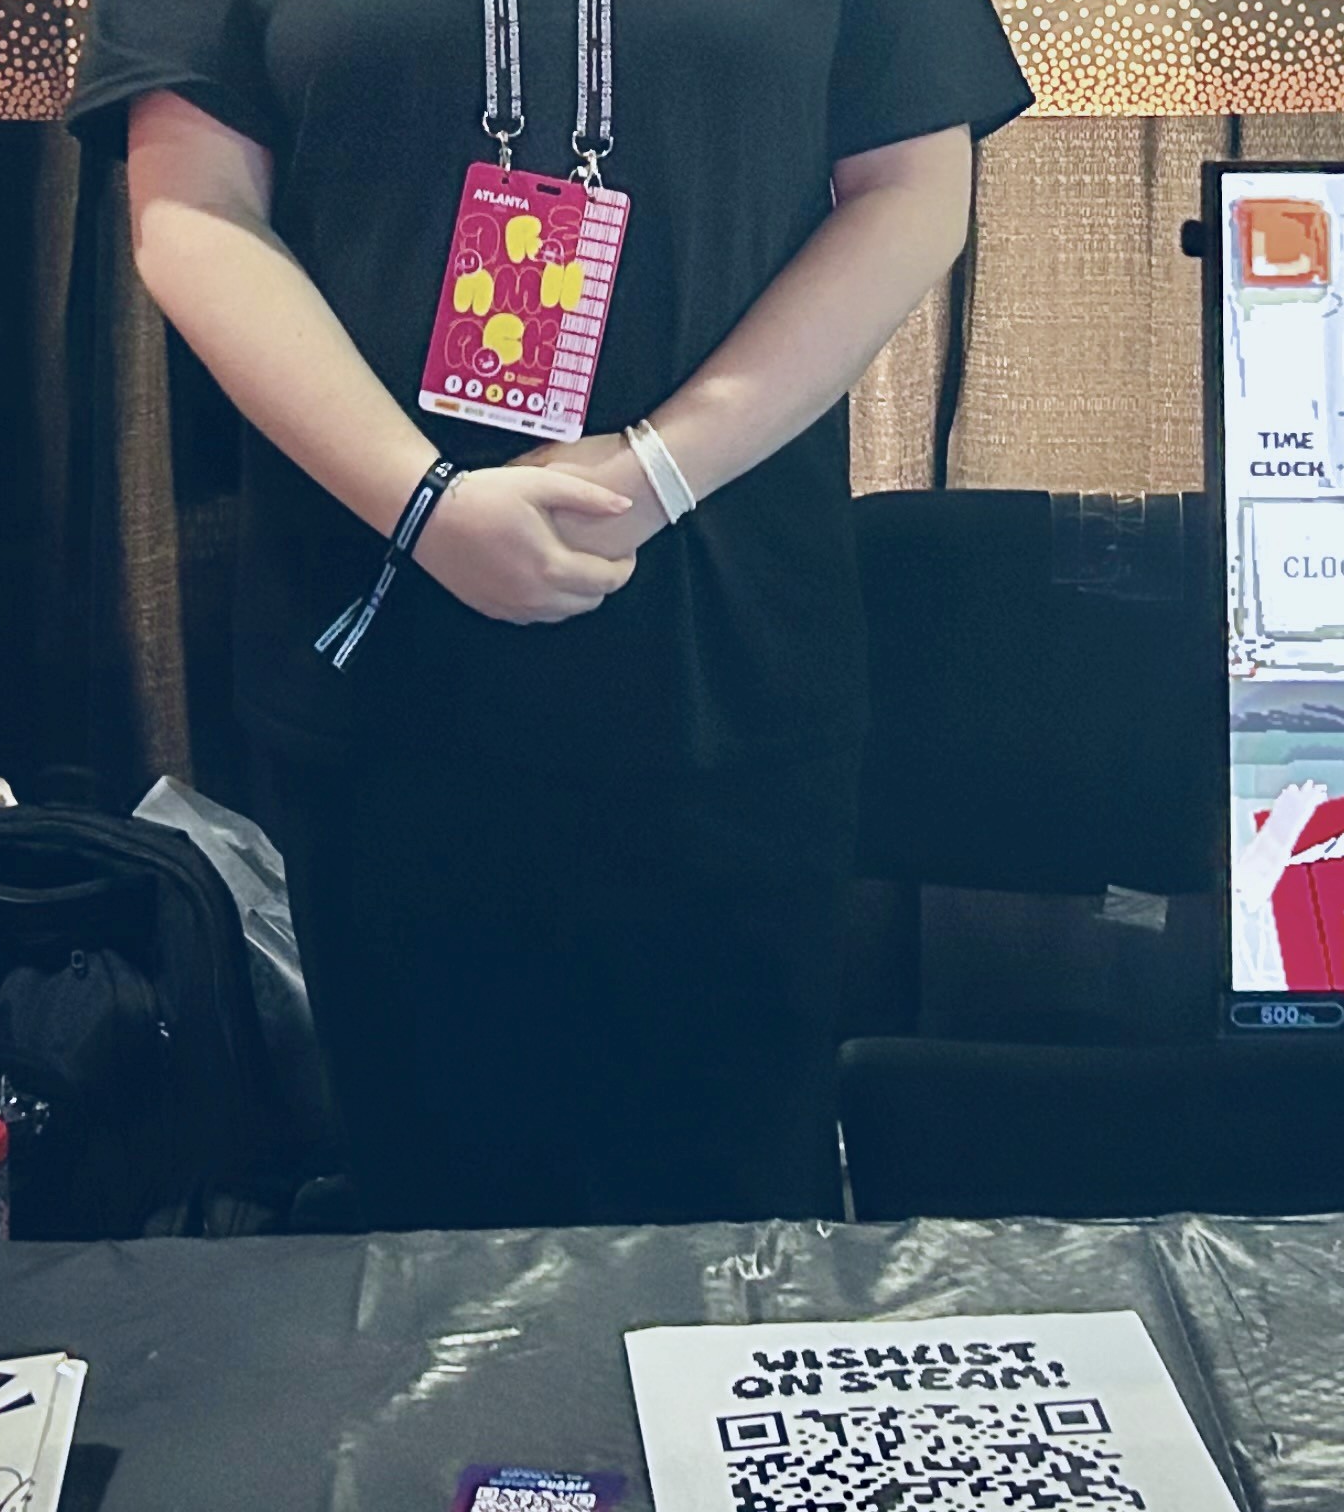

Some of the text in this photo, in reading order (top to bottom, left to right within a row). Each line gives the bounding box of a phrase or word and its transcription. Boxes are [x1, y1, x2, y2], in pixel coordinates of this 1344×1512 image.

[473, 189, 530, 211] ATLANTA
[1258, 431, 1315, 451] TIME
[1250, 458, 1325, 480] CLOCK
[752, 1341, 1037, 1372] WISHLIST
[732, 1360, 1070, 1399] ON STEAM!
